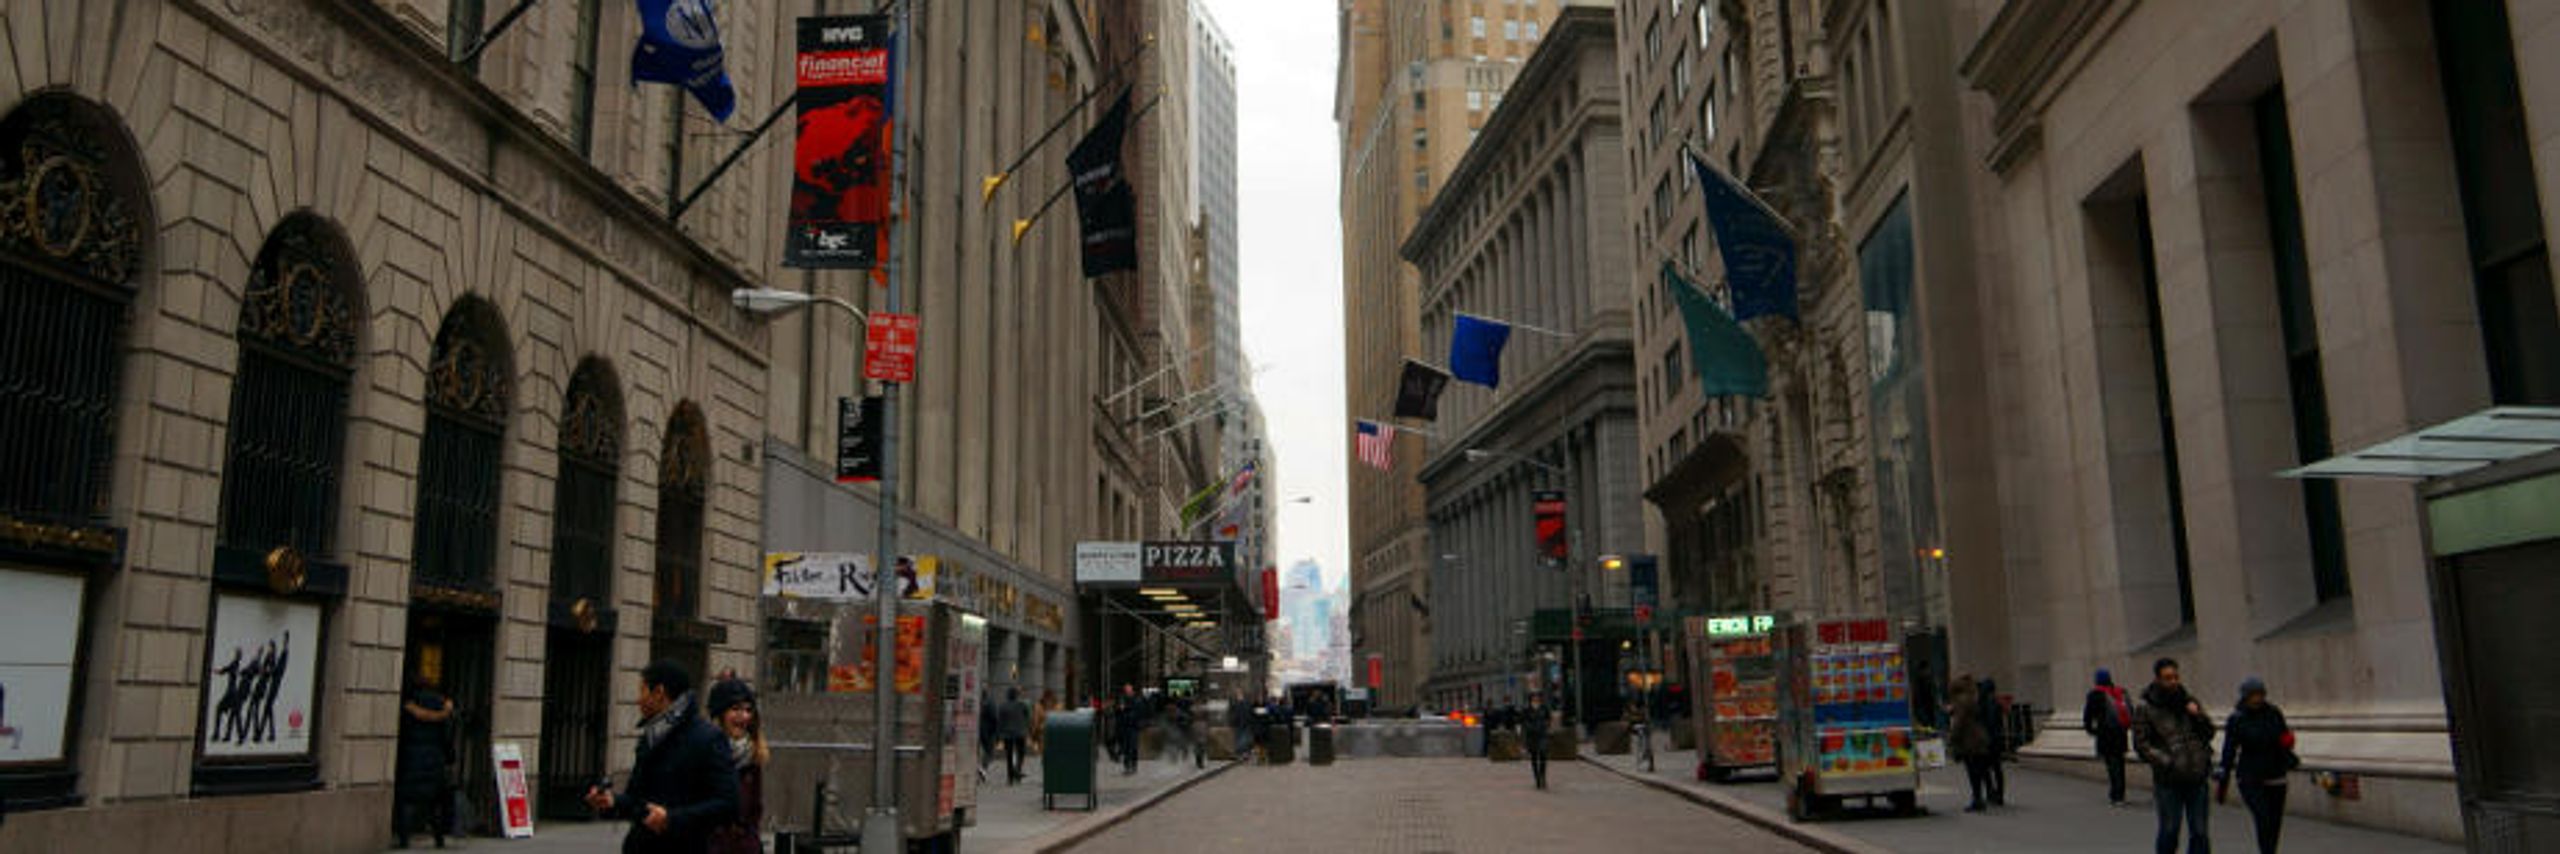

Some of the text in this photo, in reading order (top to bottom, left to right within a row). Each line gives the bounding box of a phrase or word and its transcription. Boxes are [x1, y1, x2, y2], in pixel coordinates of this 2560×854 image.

[822, 27, 863, 42] NYC
[800, 52, 885, 77] financial
[1146, 546, 1222, 567] PIZZA
